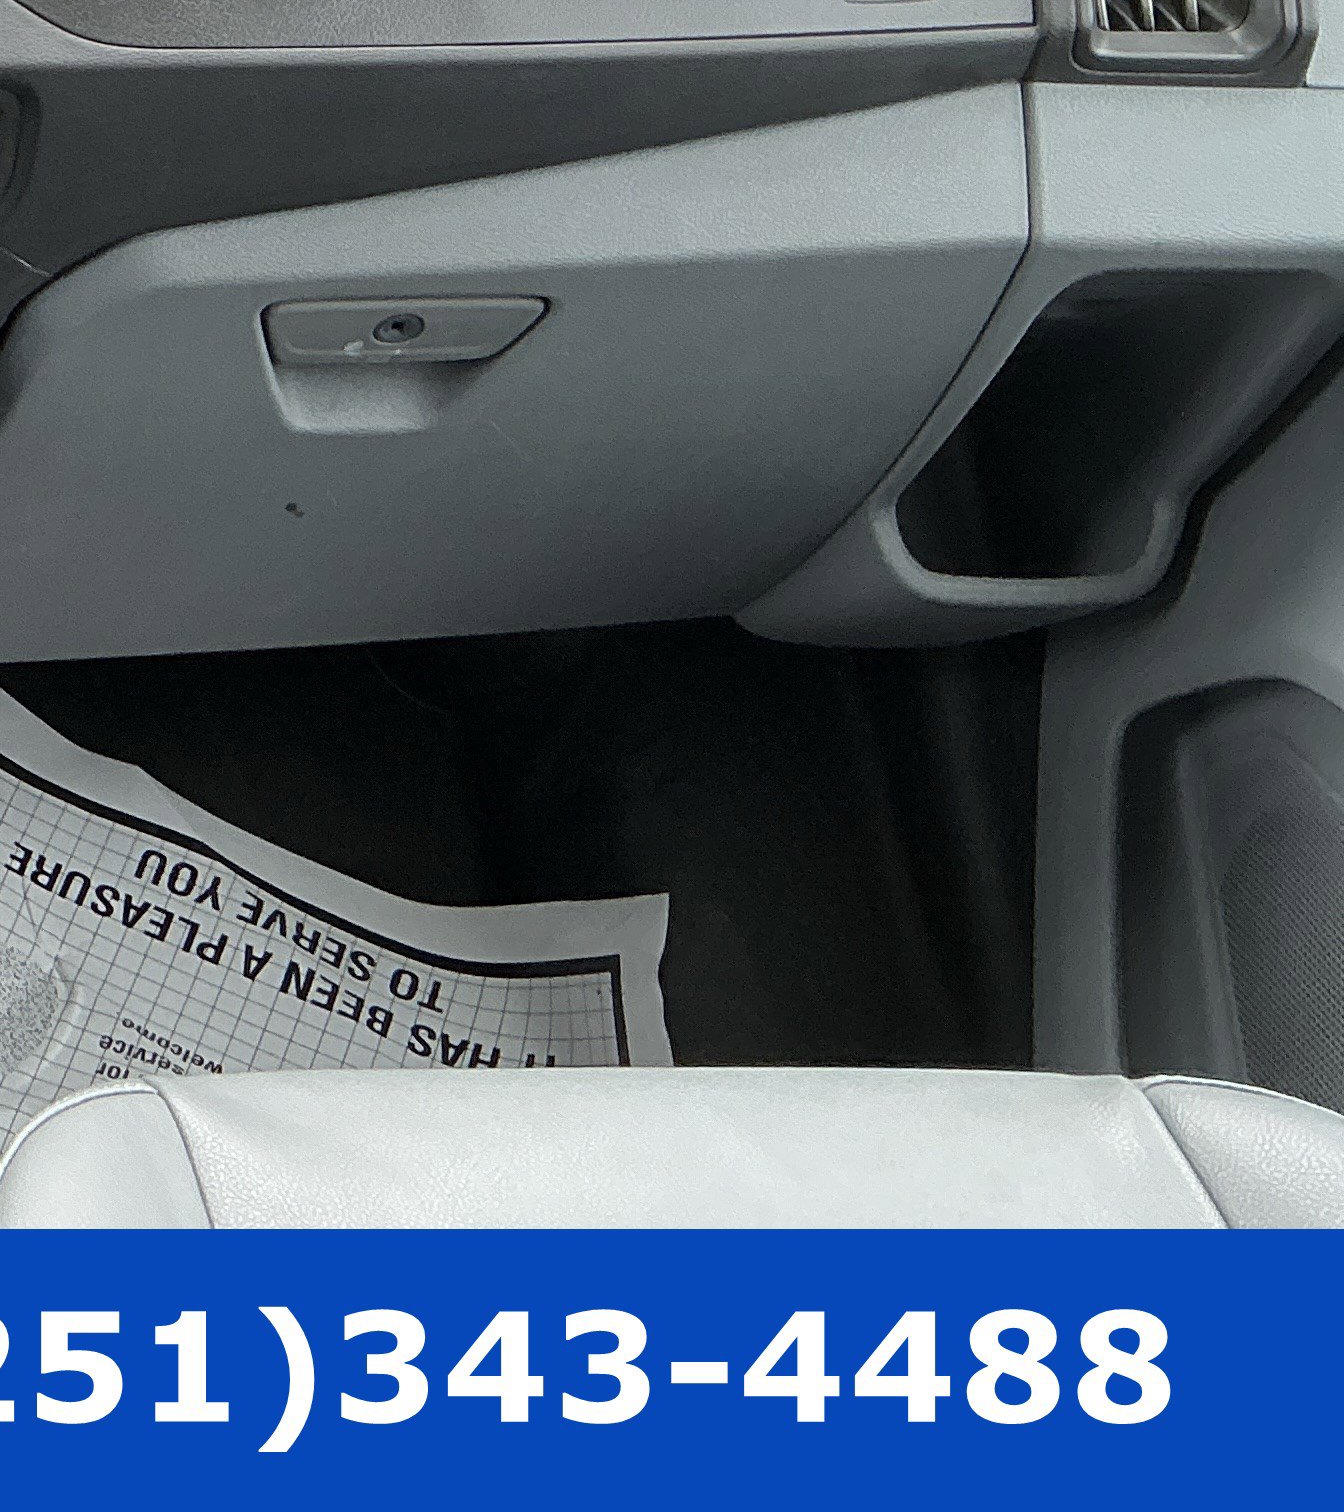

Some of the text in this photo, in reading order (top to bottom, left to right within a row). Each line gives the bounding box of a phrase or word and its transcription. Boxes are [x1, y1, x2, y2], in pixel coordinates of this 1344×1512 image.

[2, 842, 501, 1068] HAS BEEN A PLEASURE
[132, 846, 447, 1014] TO SERVE YOU
[98, 1034, 185, 1076] service
[121, 1017, 224, 1074] welcome
